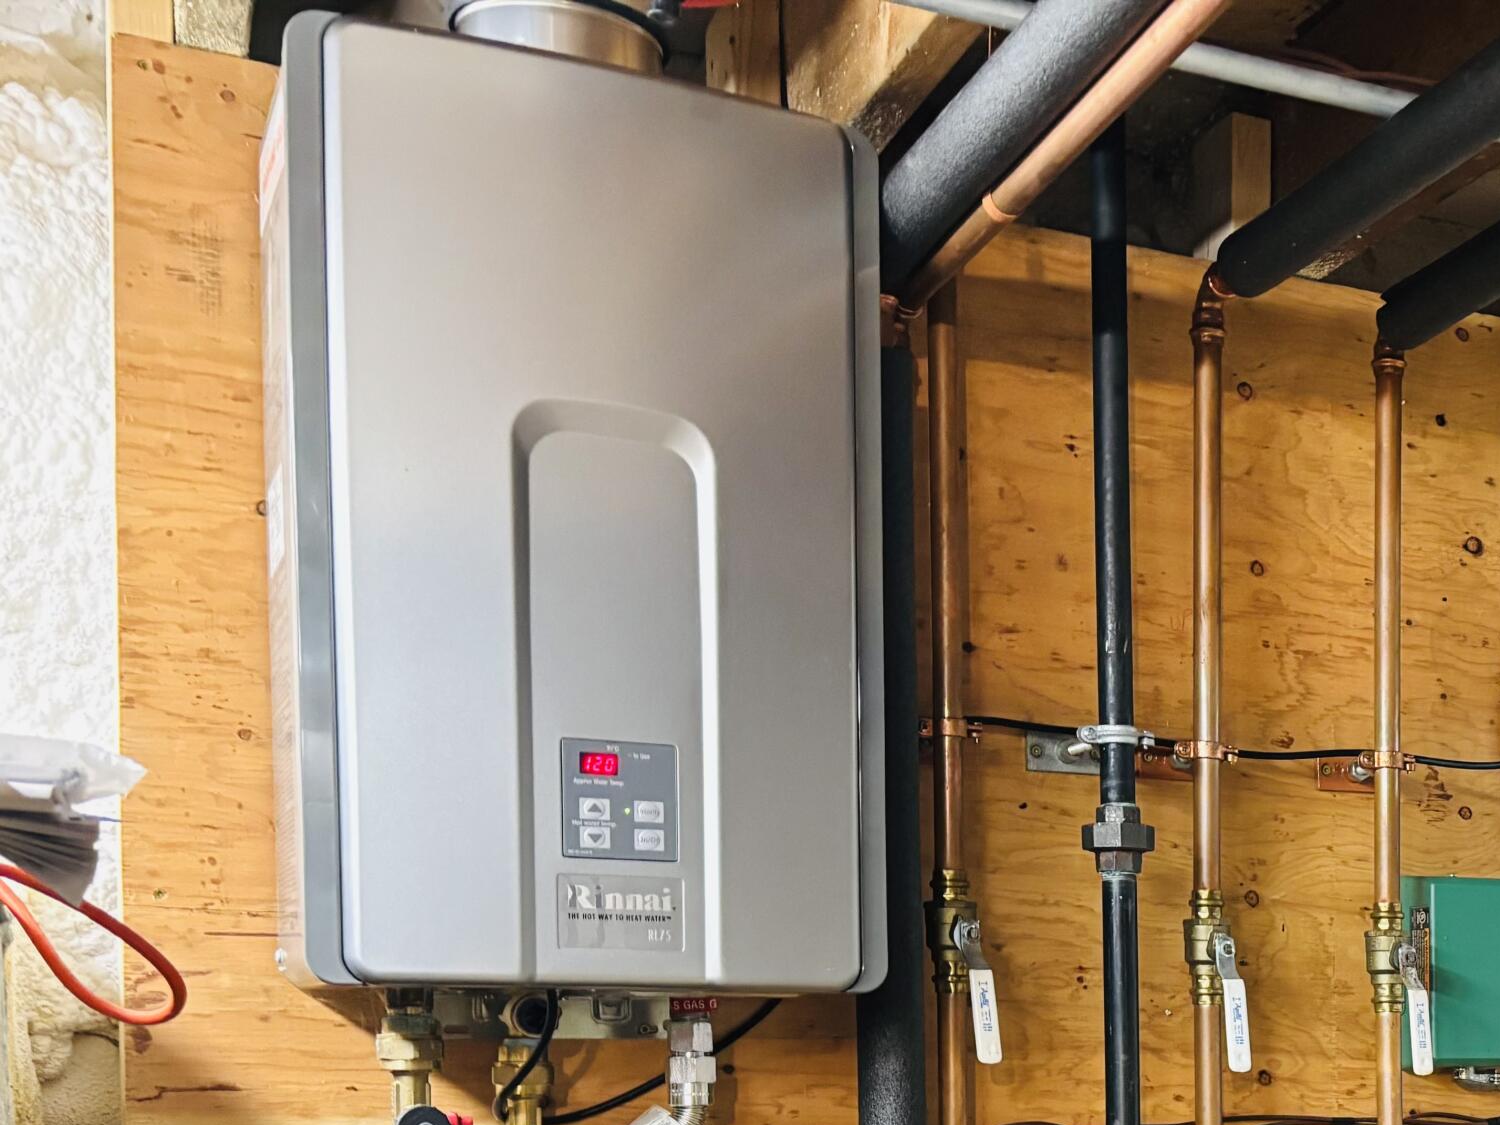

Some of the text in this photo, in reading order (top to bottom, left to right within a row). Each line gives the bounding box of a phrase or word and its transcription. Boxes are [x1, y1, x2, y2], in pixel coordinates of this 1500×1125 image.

[585, 756, 614, 772] 120
[567, 883, 672, 912] Rinnai
[568, 912, 580, 920] THE
[626, 914, 642, 922] HEAT
[683, 999, 705, 1010] GAS
